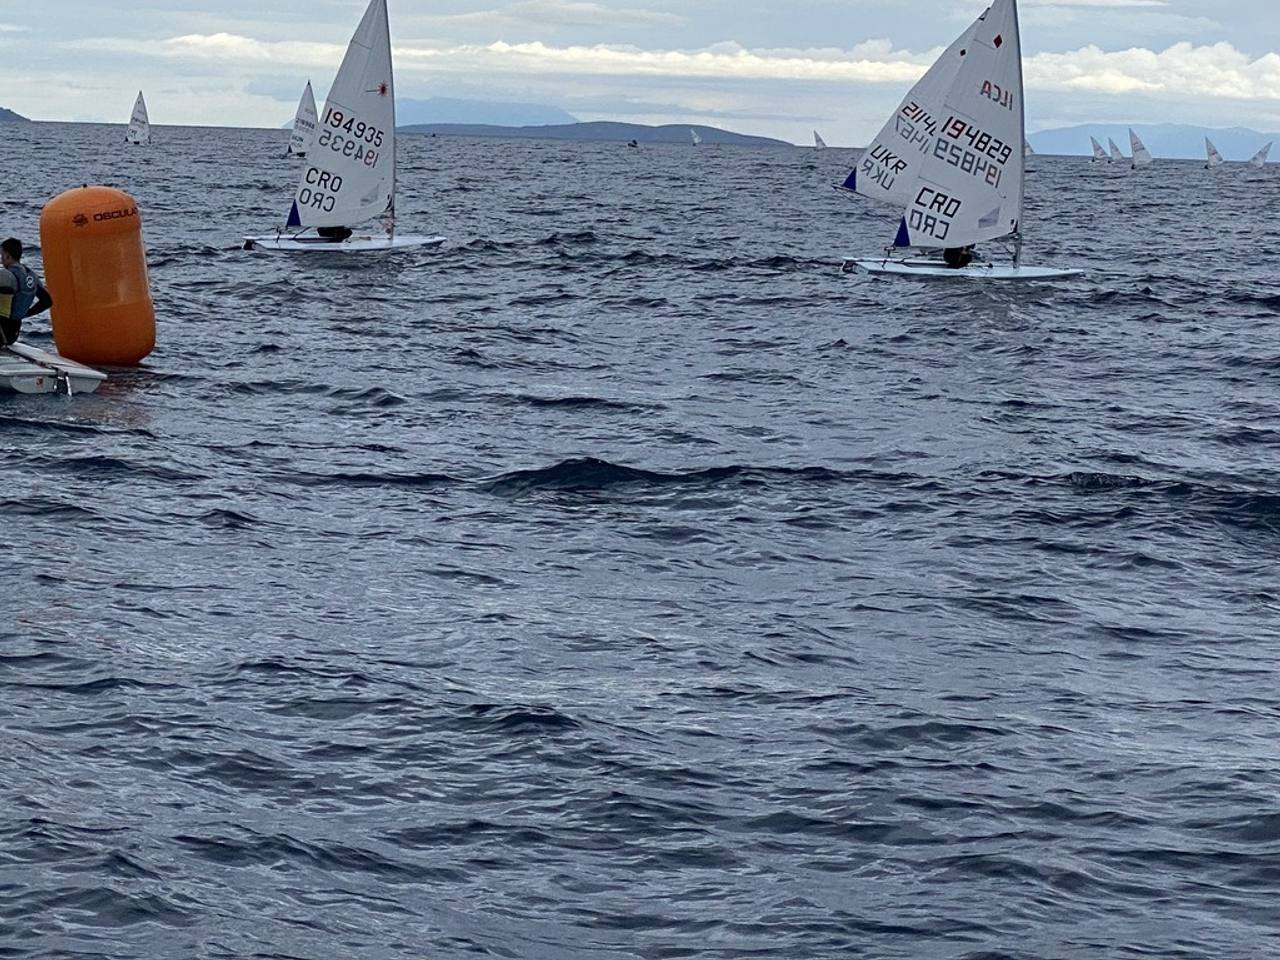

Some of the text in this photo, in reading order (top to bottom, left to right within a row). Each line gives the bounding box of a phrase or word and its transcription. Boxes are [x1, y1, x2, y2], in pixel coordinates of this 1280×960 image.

[324, 108, 384, 147] 194935
[941, 116, 1012, 165] 194829
[870, 145, 907, 174] UKR
[306, 168, 342, 192] CRO
[915, 187, 961, 218] CRO
